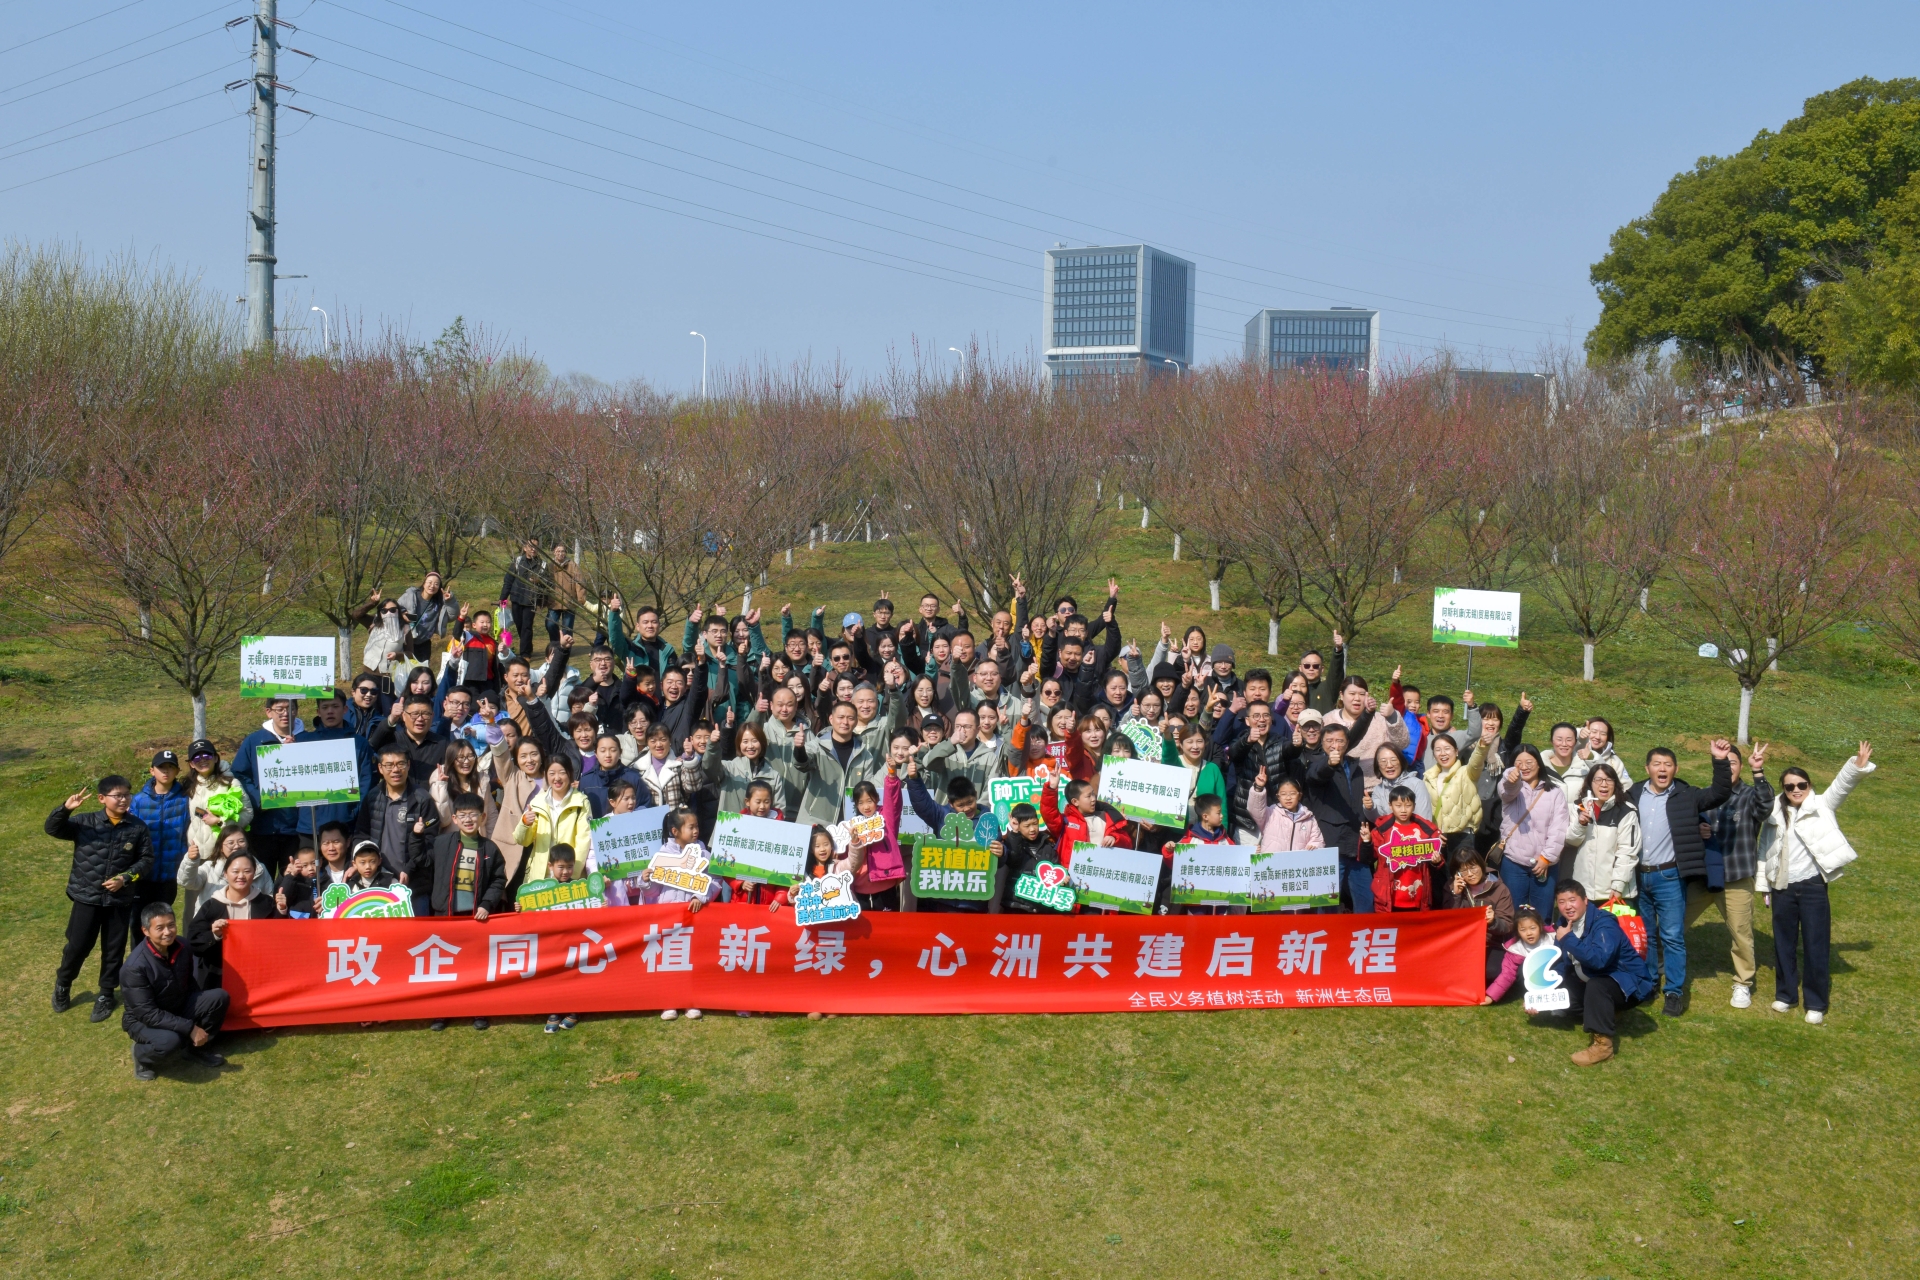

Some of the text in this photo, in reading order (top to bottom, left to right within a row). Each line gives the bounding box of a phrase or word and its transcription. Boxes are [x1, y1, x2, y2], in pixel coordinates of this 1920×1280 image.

[1442, 607, 1512, 621] 阿斯利康(无锡)贸易有限公司
[248, 655, 327, 667] 无锡保利音乐厅运营管理
[273, 669, 302, 680] 有限公司
[163, 750, 172, 759] C
[264, 760, 353, 778] SK海力士半导体(中国)有限公司
[1109, 777, 1180, 798] 无锡村田电子有限公司
[624, 846, 649, 861] 有限公司
[718, 834, 803, 858] 村田新能源(无锡)有限公司
[1391, 843, 1434, 857] 硬核团队
[920, 847, 991, 870] 我植树
[652, 866, 709, 892] 勇往直前
[1043, 870, 1058, 886] 爱
[1073, 863, 1154, 886] 希捷国际科技(无锡)有限公司
[1180, 865, 1250, 876] 捷普电子(无锡)有限公司
[919, 869, 987, 893] 我快乐
[1281, 880, 1309, 893] 有限公司
[519, 882, 589, 911] 植树造林
[800, 883, 814, 897] 冲
[1018, 875, 1075, 910] 植树季
[797, 894, 822, 909] 冲冲
[797, 903, 860, 924] 勇往直前冲
[325, 922, 1399, 986] 政企同心植新绿，心洲共建启新程
[1128, 986, 1394, 1008] 全民义务植树活动 新洲生态园
[1528, 991, 1566, 1005] 新洲生态园
